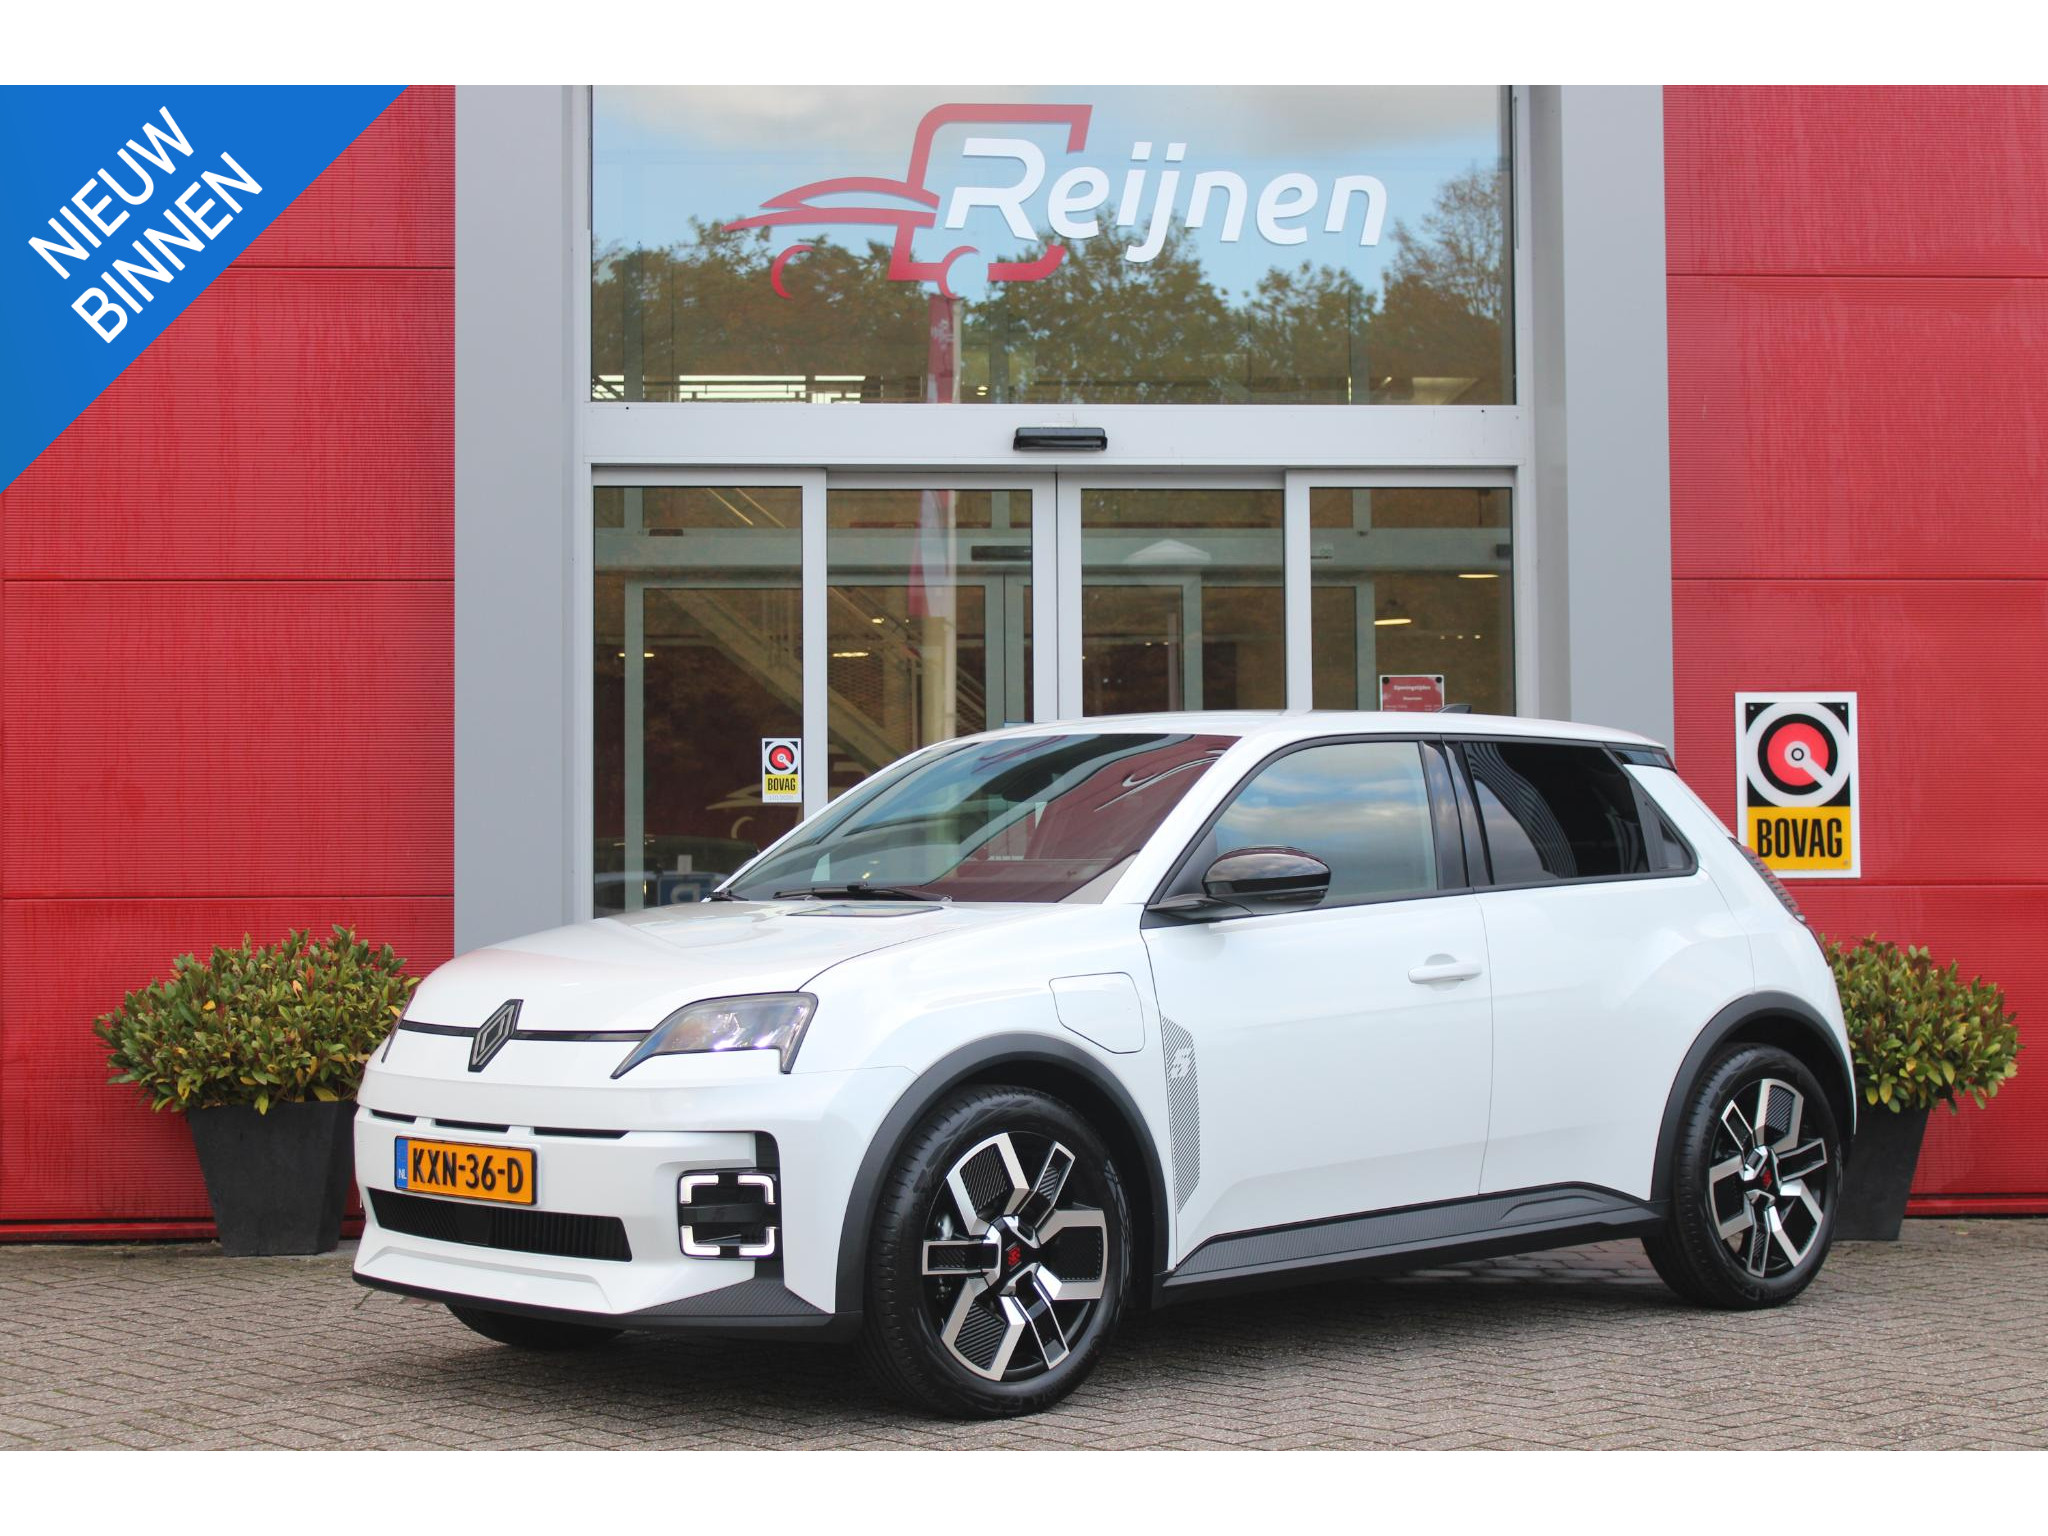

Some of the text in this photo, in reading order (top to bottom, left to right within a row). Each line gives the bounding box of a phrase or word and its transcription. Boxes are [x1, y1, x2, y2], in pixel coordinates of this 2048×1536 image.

[945, 137, 1388, 263] Reijnen
[767, 777, 796, 791] BOVAG
[1756, 817, 1843, 859] BOVAG
[398, 1168, 407, 1180] NL
[412, 1147, 524, 1194] KXN-36-D
